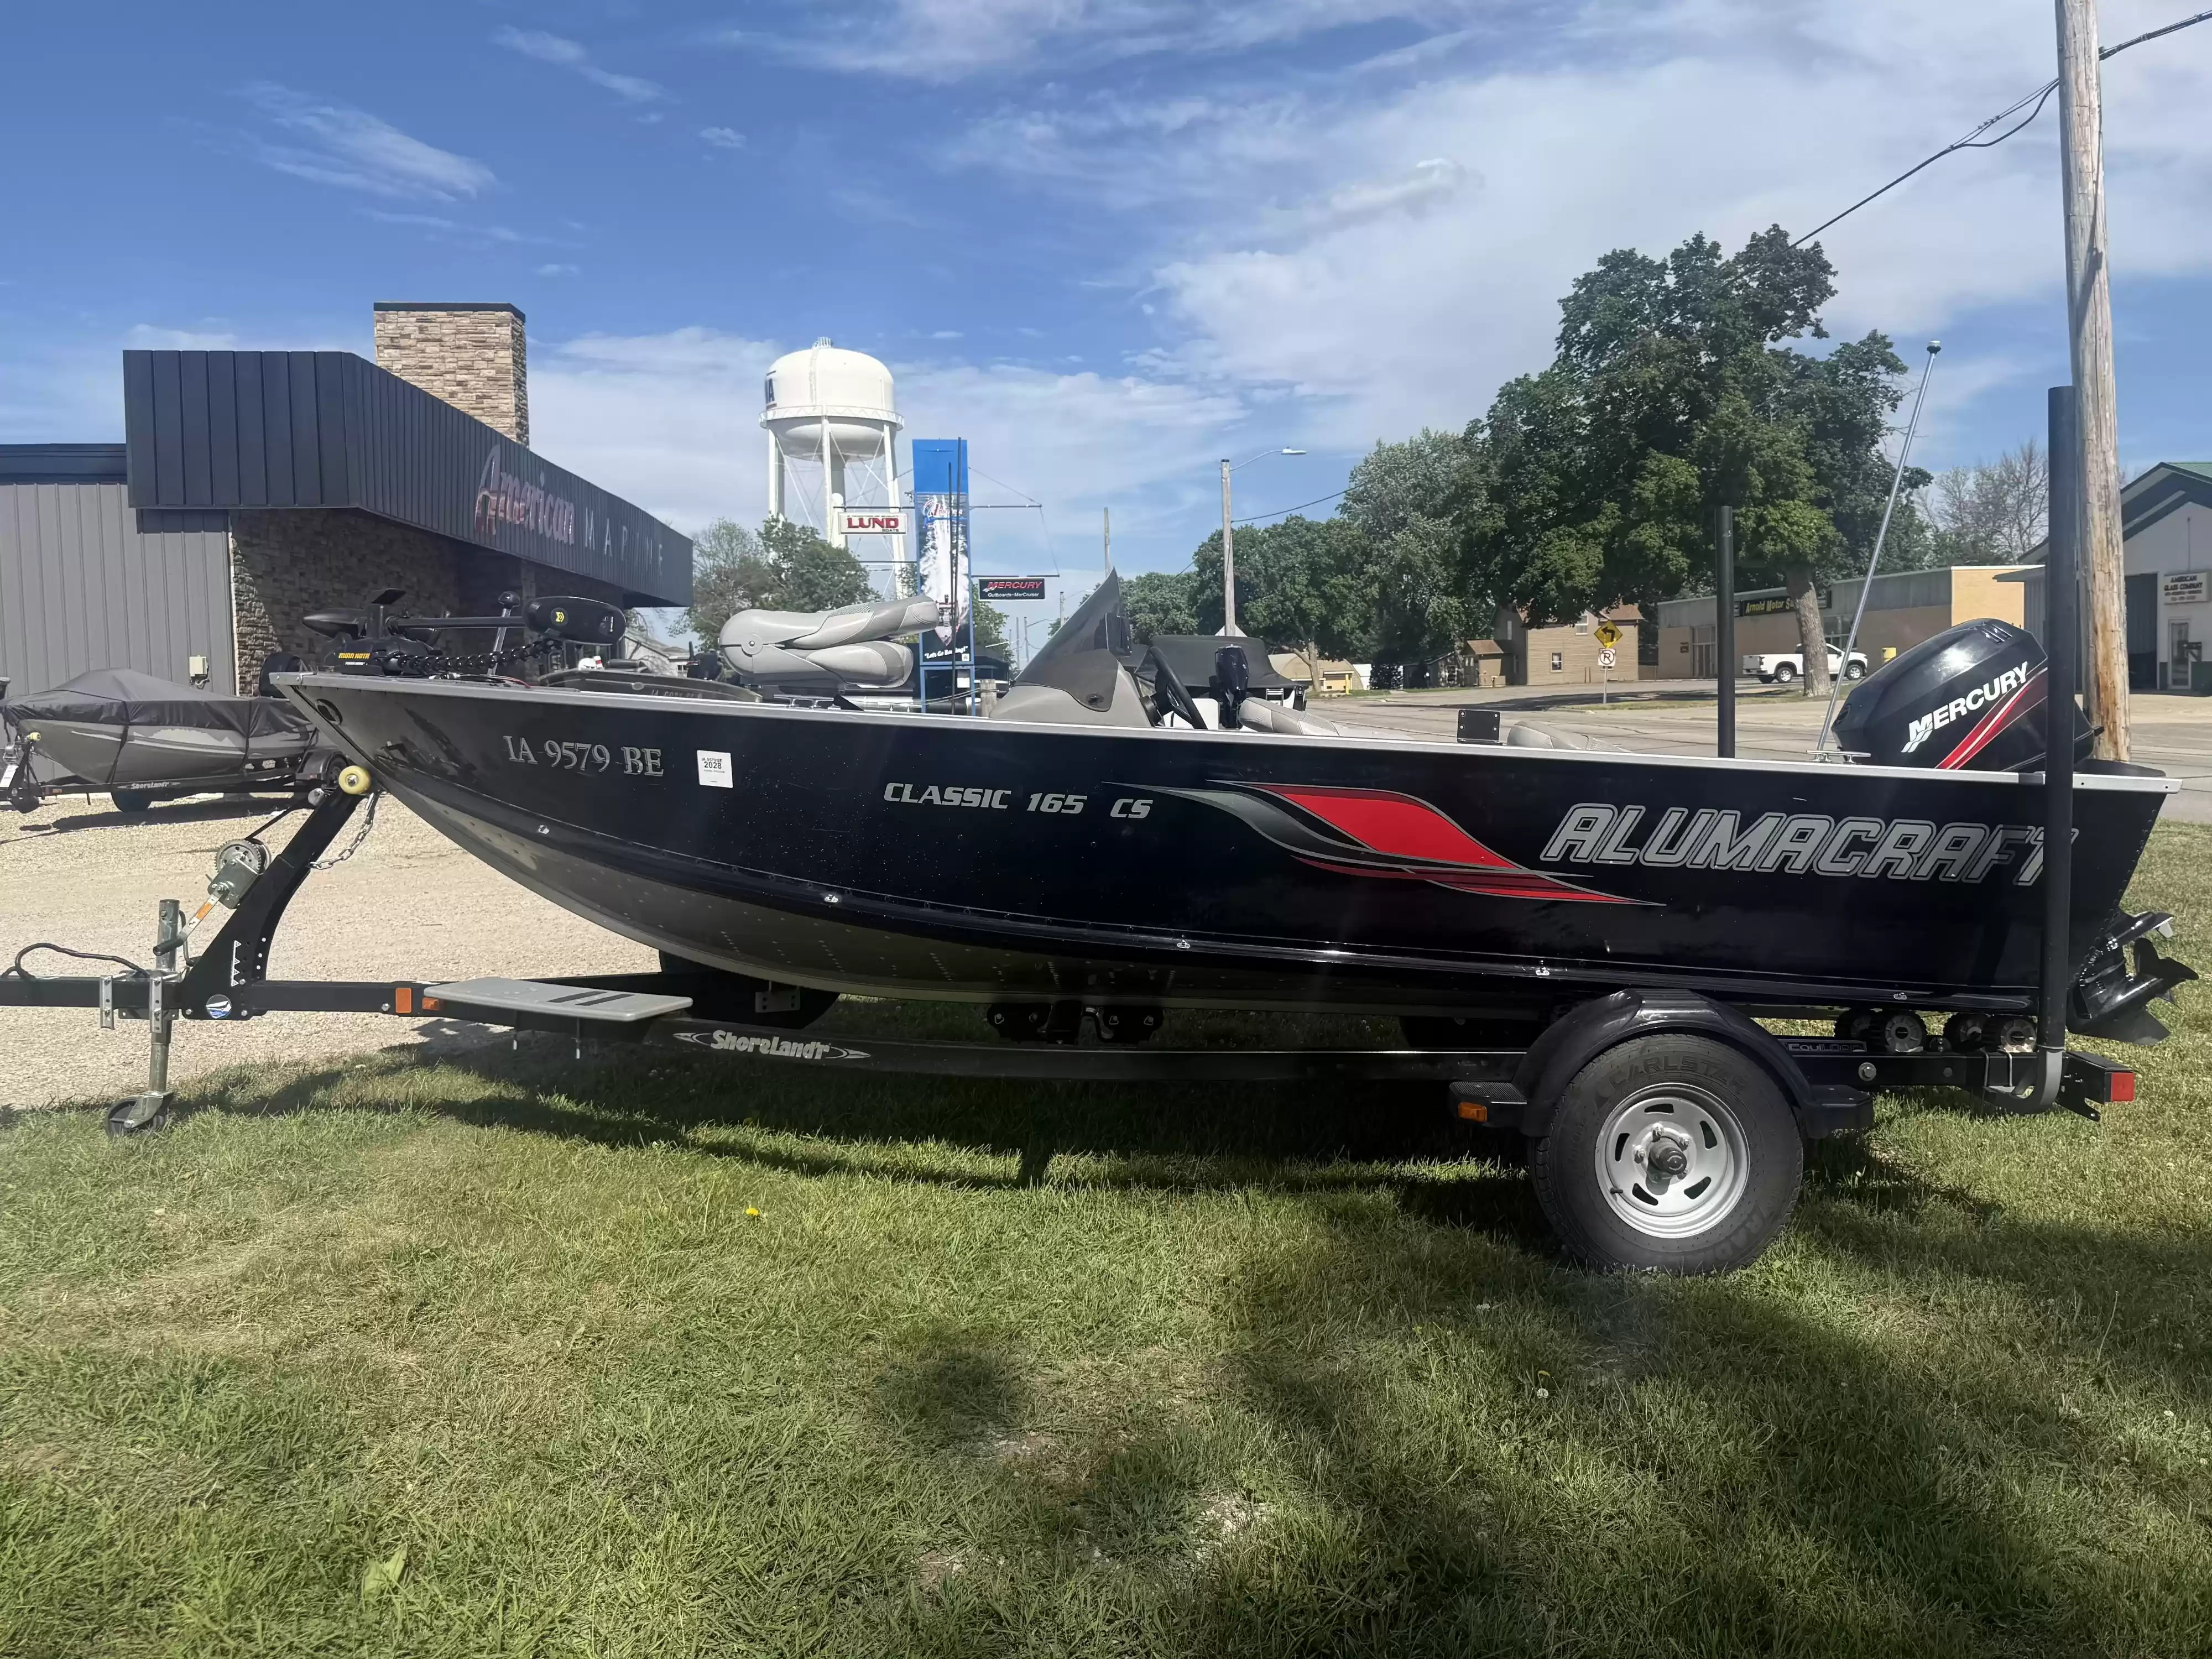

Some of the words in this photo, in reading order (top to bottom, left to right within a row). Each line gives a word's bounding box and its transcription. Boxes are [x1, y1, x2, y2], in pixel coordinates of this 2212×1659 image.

[474, 444, 575, 546] American
[847, 517, 899, 529] LUND
[983, 581, 1042, 592] MERCURY
[1745, 601, 1766, 613] Arnold
[1766, 599, 1784, 612] Motor
[1902, 661, 2028, 751] MERCURY
[503, 735, 538, 765] IA
[544, 740, 611, 773] 9579
[620, 746, 664, 776] BE
[884, 782, 1011, 809] CLASSIC
[1026, 792, 1088, 814] 165
[1110, 799, 1154, 818] CS
